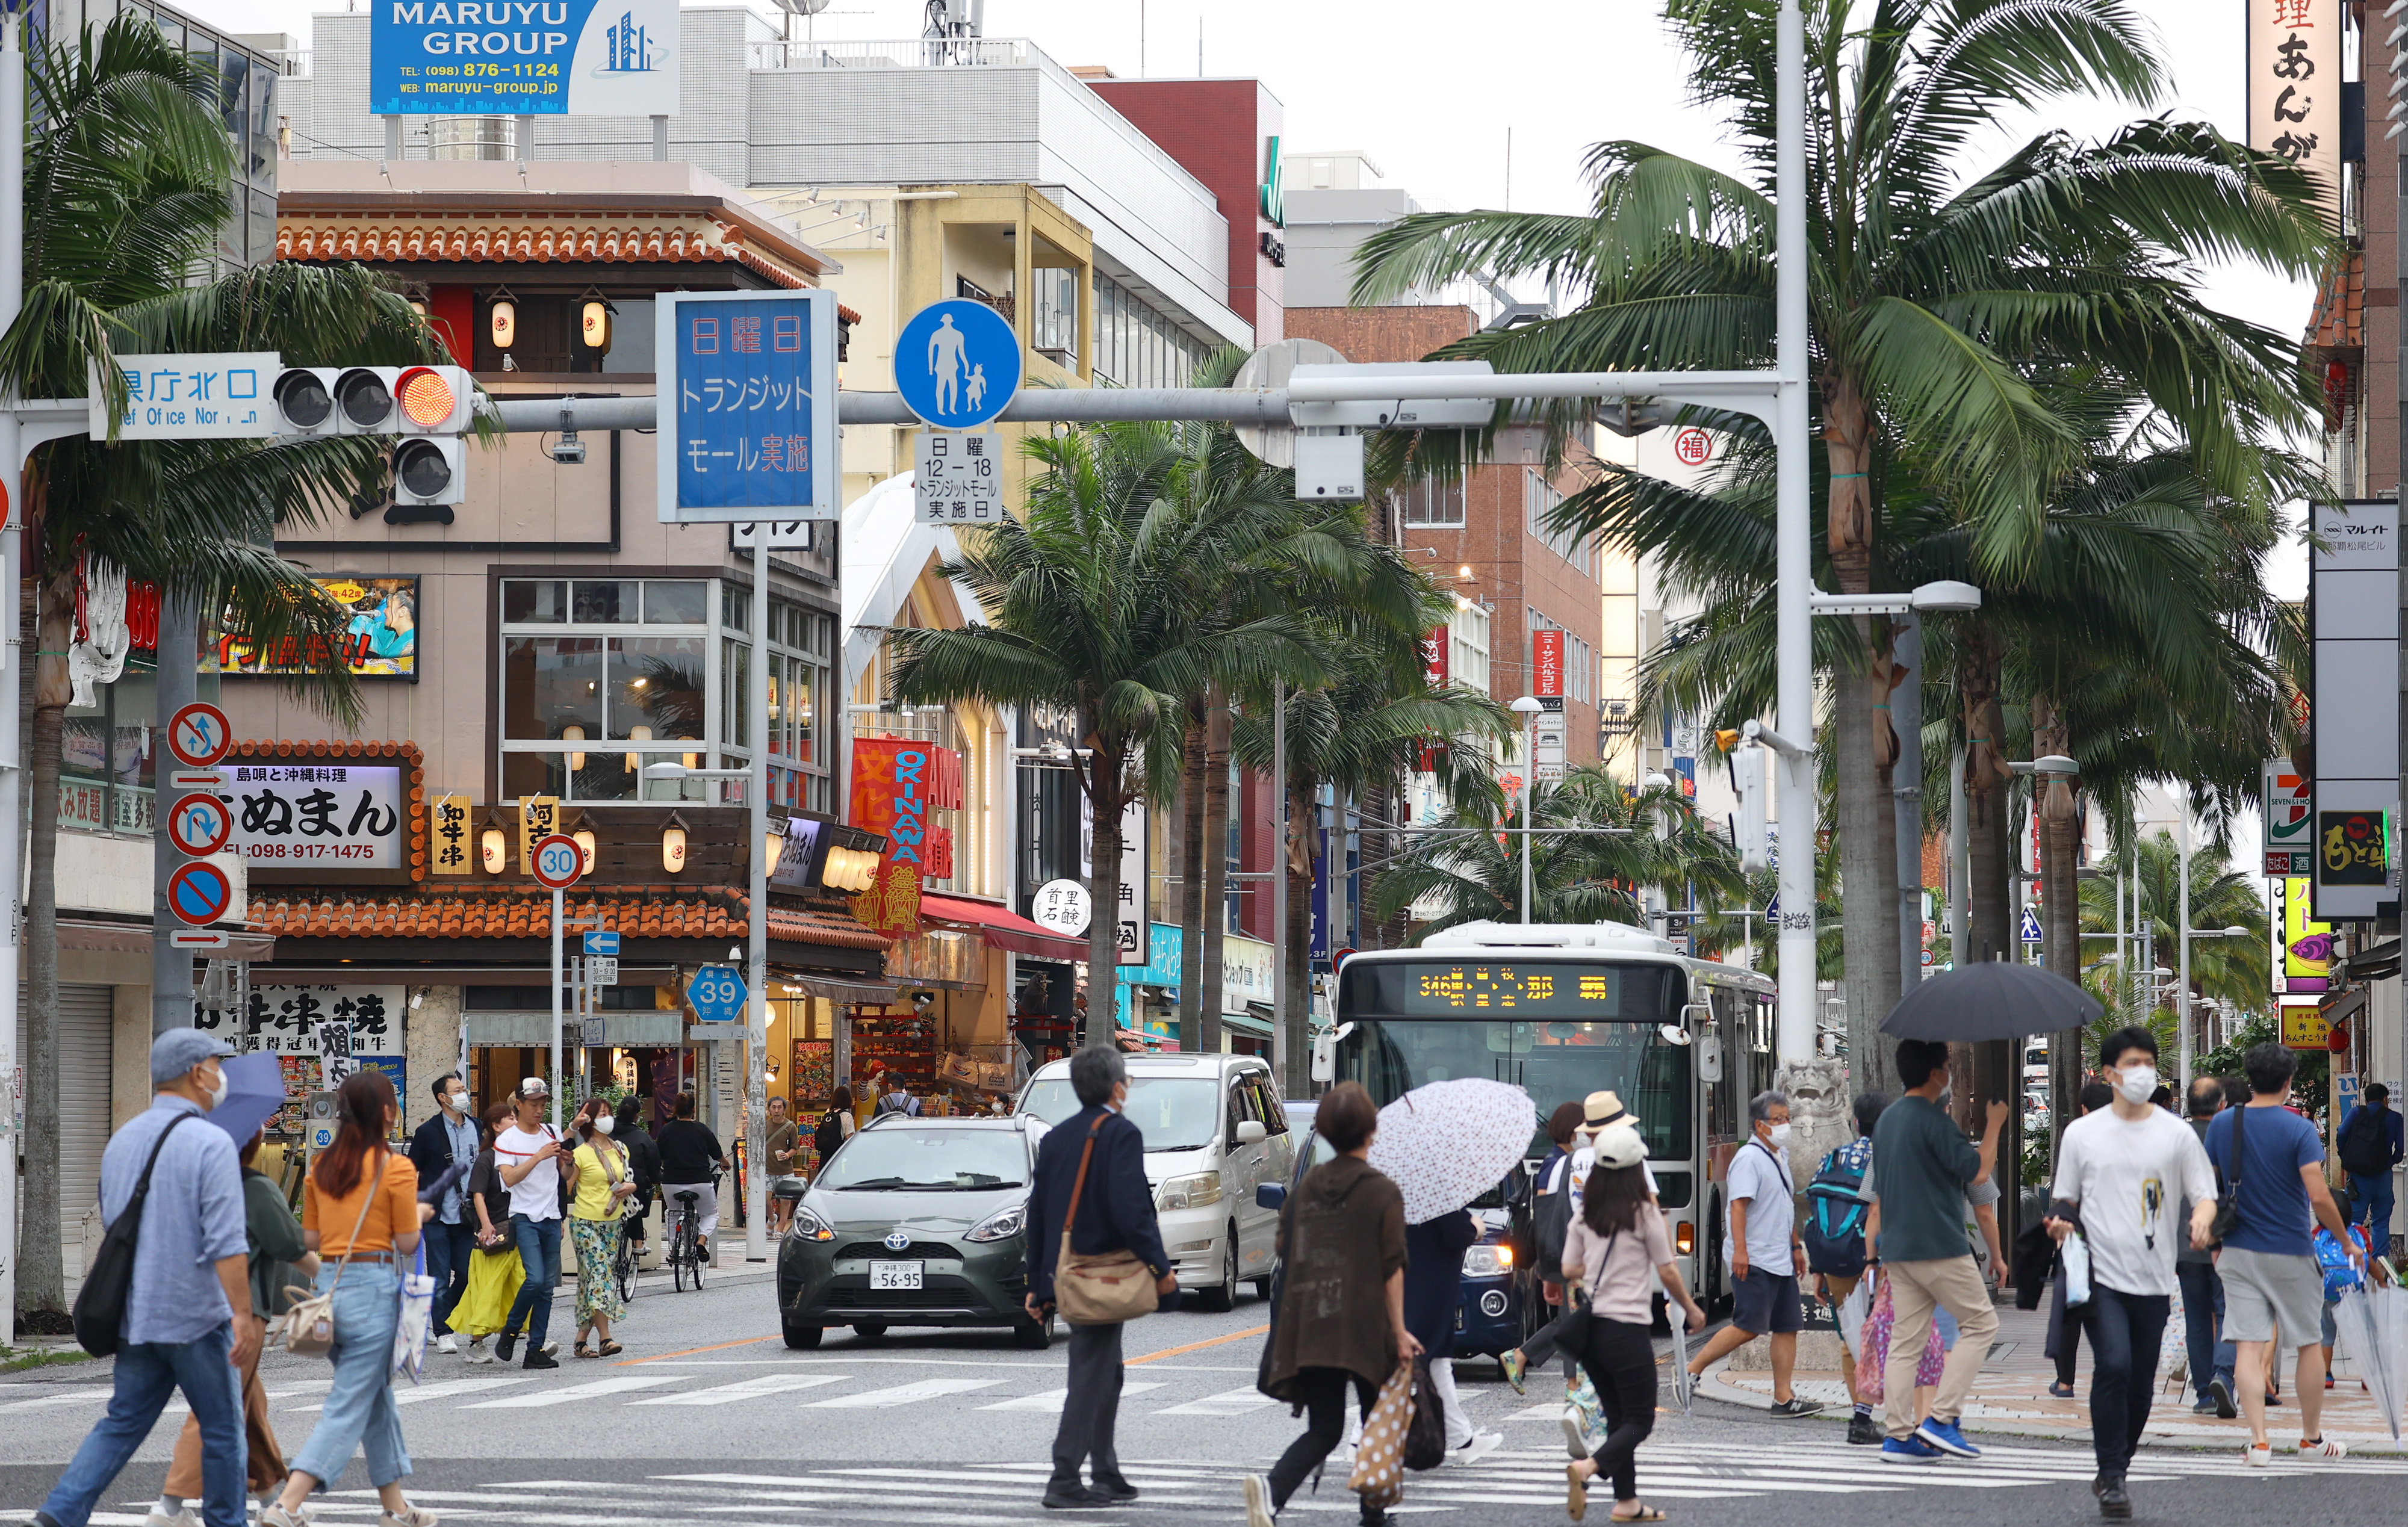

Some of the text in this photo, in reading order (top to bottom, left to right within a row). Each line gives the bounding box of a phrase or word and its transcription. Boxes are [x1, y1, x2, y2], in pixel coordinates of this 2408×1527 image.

[392, 2, 568, 25] MARUYU
[423, 31, 568, 55] GROUP
[400, 63, 559, 76] TEL: (098) 876-1124
[400, 81, 558, 94] WEB: maruyu-group.jp
[692, 317, 801, 355] 日曜日
[115, 369, 257, 402] 県庁北口
[683, 374, 812, 413] トランジット
[687, 433, 808, 473] モール実施
[932, 438, 983, 457] 日曜
[1681, 438, 1704, 457] 福
[925, 459, 943, 477] 12
[973, 459, 991, 477] 18
[919, 478, 996, 498] トランジットモール
[929, 500, 988, 518] 実施日
[2344, 525, 2389, 535] マルイト
[1541, 632, 1555, 694] ニューサンパルコビル
[237, 767, 347, 782] 島唄と沖縄料理
[889, 751, 926, 863] OKINAWA
[543, 850, 573, 873] 30
[2267, 856, 2289, 872] たばこ
[1047, 888, 1078, 906] 首里
[706, 970, 731, 979] 県道
[700, 981, 736, 1003] 39
[2298, 1023, 2327, 1032] 新垣
[318, 1132, 329, 1143] 39
[881, 1273, 920, 1287] 56-95
